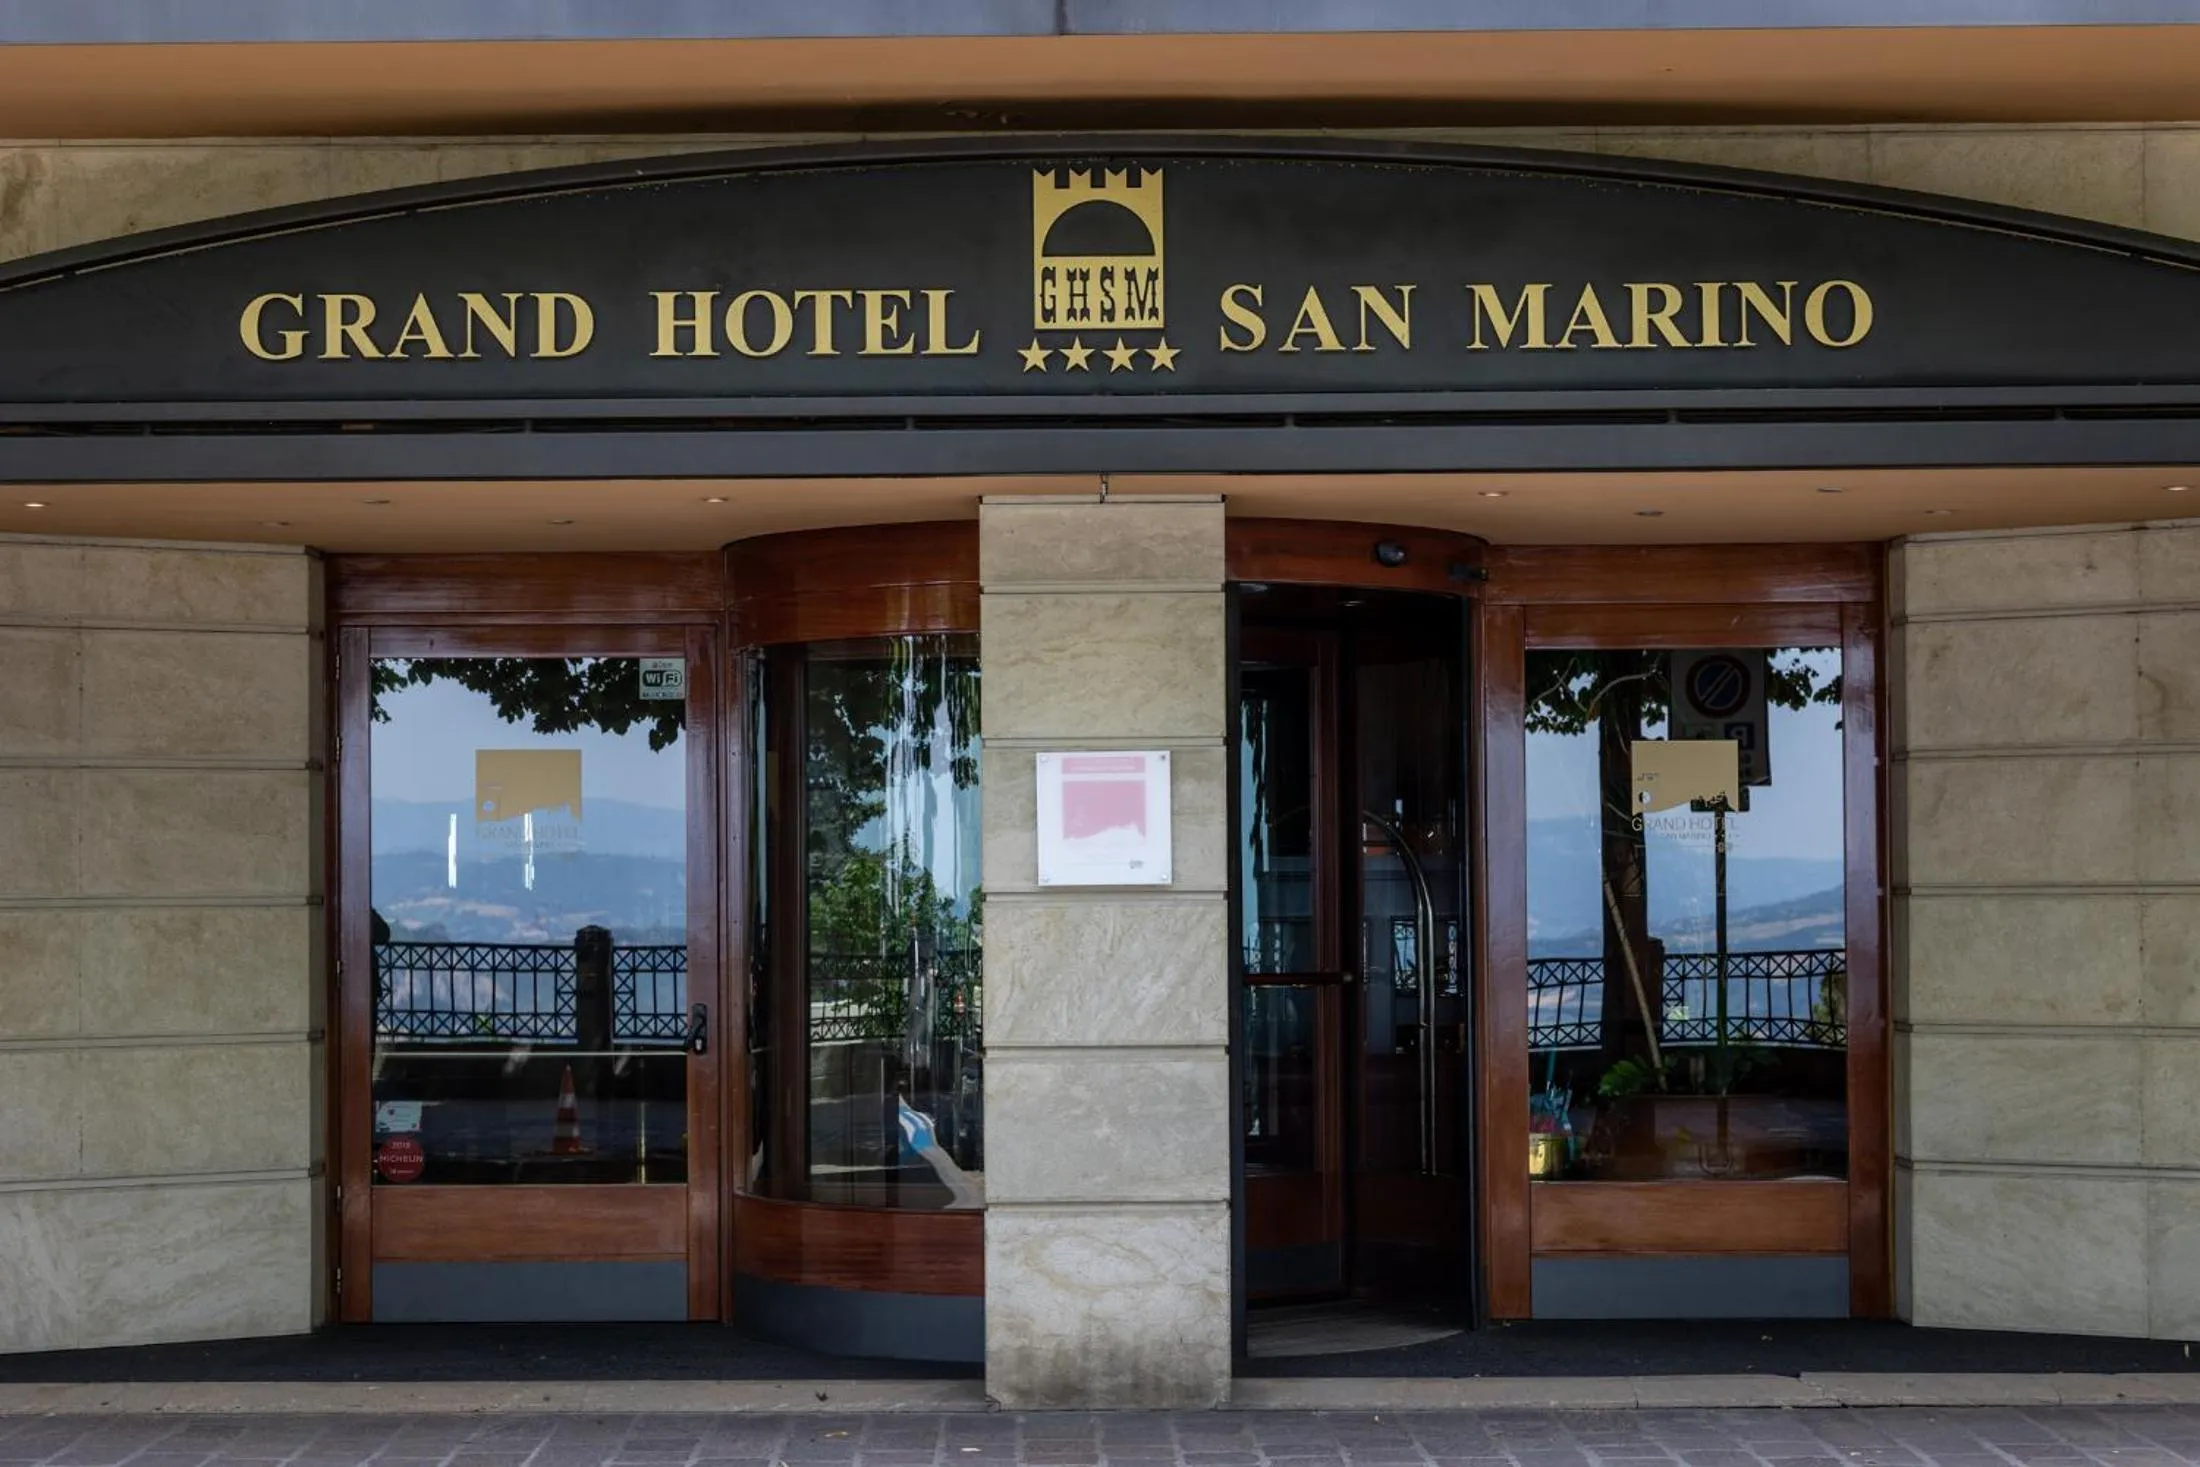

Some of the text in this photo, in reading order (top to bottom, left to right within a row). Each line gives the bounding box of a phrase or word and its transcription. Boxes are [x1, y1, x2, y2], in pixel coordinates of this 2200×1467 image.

[239, 280, 1873, 360] GRAND HOTEL SAN MARINO
[1040, 266, 1159, 323] GHSM
